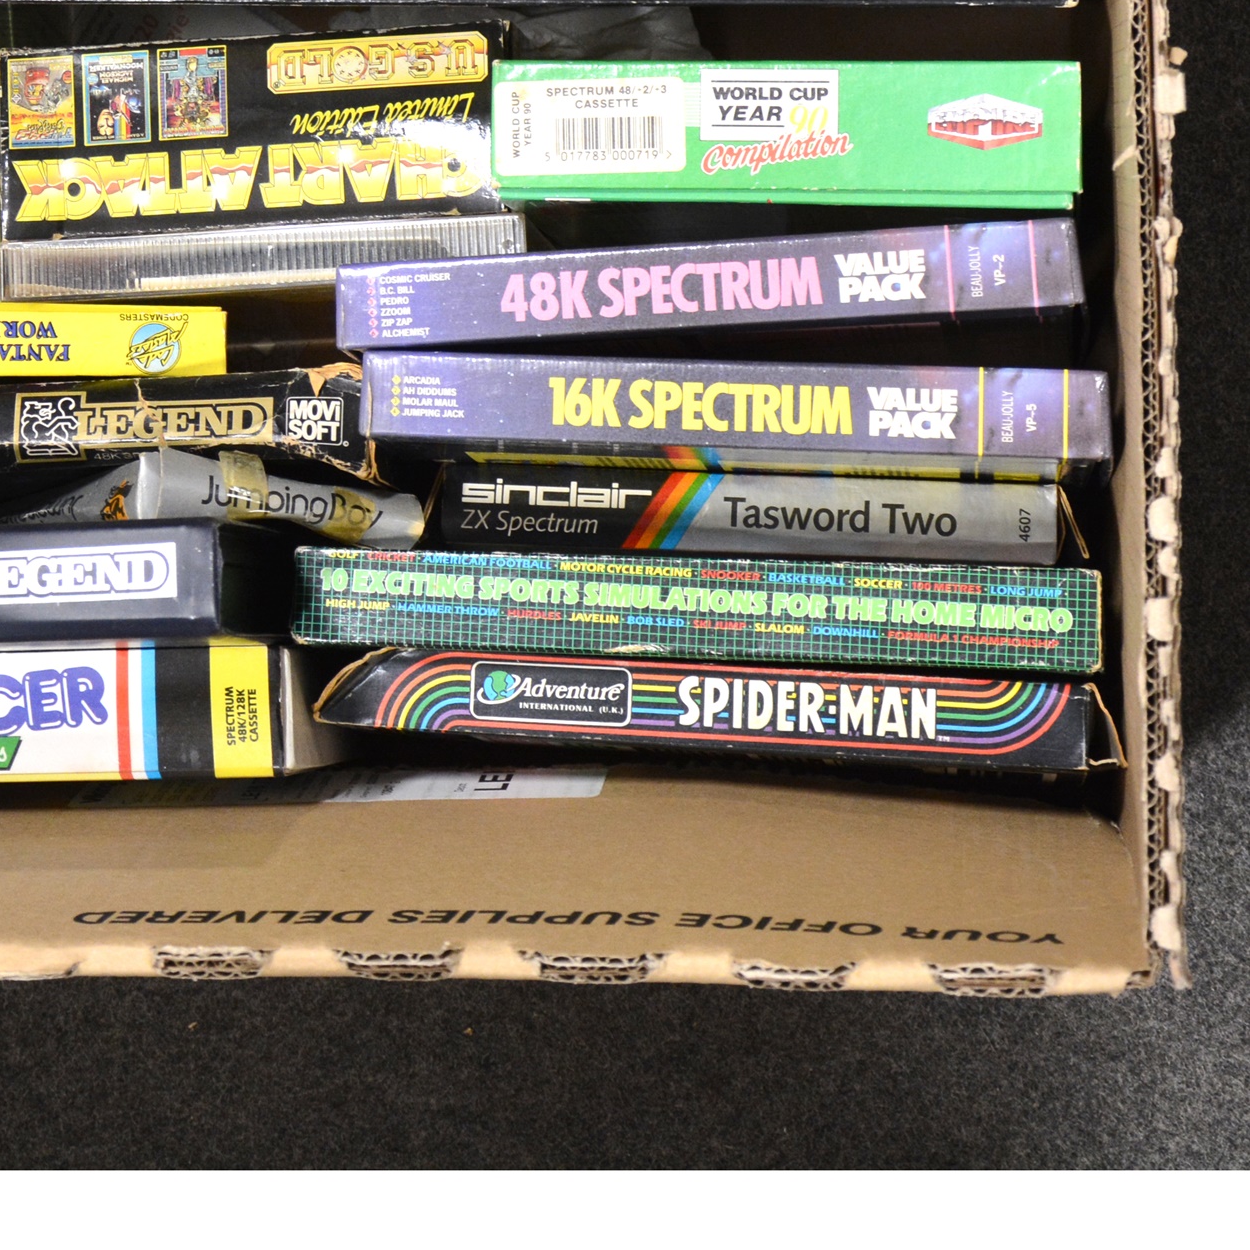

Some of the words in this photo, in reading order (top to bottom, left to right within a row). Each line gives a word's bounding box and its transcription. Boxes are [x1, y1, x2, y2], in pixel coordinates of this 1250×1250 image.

[546, 86, 615, 97] SPECTRUM
[575, 98, 639, 109] CASSETTE
[711, 86, 782, 102] WORLD
[787, 84, 829, 100] CUP
[290, 106, 376, 136] Edition
[379, 92, 475, 127] Limited
[717, 104, 782, 122] YEAR
[13, 146, 262, 222] ATTACK
[834, 249, 926, 280] VALUE
[968, 246, 983, 298] BEAU-JOLLY
[380, 275, 412, 284] COSMIC
[414, 273, 450, 282] CRUISER
[500, 269, 592, 322] 48K
[598, 256, 824, 318] SPECTRUM
[838, 274, 927, 305] PACK
[380, 297, 409, 305] PEDRO
[403, 376, 440, 384] ARCADIA
[548, 377, 622, 429] 16K
[628, 378, 854, 436] SPECTRUM
[867, 386, 958, 414] VALUE
[869, 410, 957, 440] PACK
[1002, 390, 1014, 443] BEAU-JOLLY
[461, 482, 652, 510] sinclair
[461, 510, 492, 530] ZX
[495, 511, 598, 537] Spectrum
[723, 495, 872, 533] Tasword
[881, 504, 957, 537] Two
[1019, 508, 1032, 543] 4607
[768, 573, 846, 586] BASKETBALL
[854, 577, 903, 589] SOCCER
[320, 567, 349, 592] 10
[351, 569, 474, 599] EXCITING
[478, 577, 580, 604] SPORTS
[583, 581, 768, 616] SIMULATIONS
[771, 592, 828, 618] FOR
[830, 596, 887, 621] THE
[890, 600, 976, 627] HOME
[980, 605, 1074, 633] MICRO
[515, 676, 626, 703] Adventure
[518, 702, 594, 714] INTERNATIONAL
[598, 706, 625, 716] (U.K.)
[72, 911, 373, 925] DELIVERED
[391, 910, 661, 927] SUPPLIES
[676, 913, 882, 936] OFFICE
[900, 927, 1066, 945] YOUR
